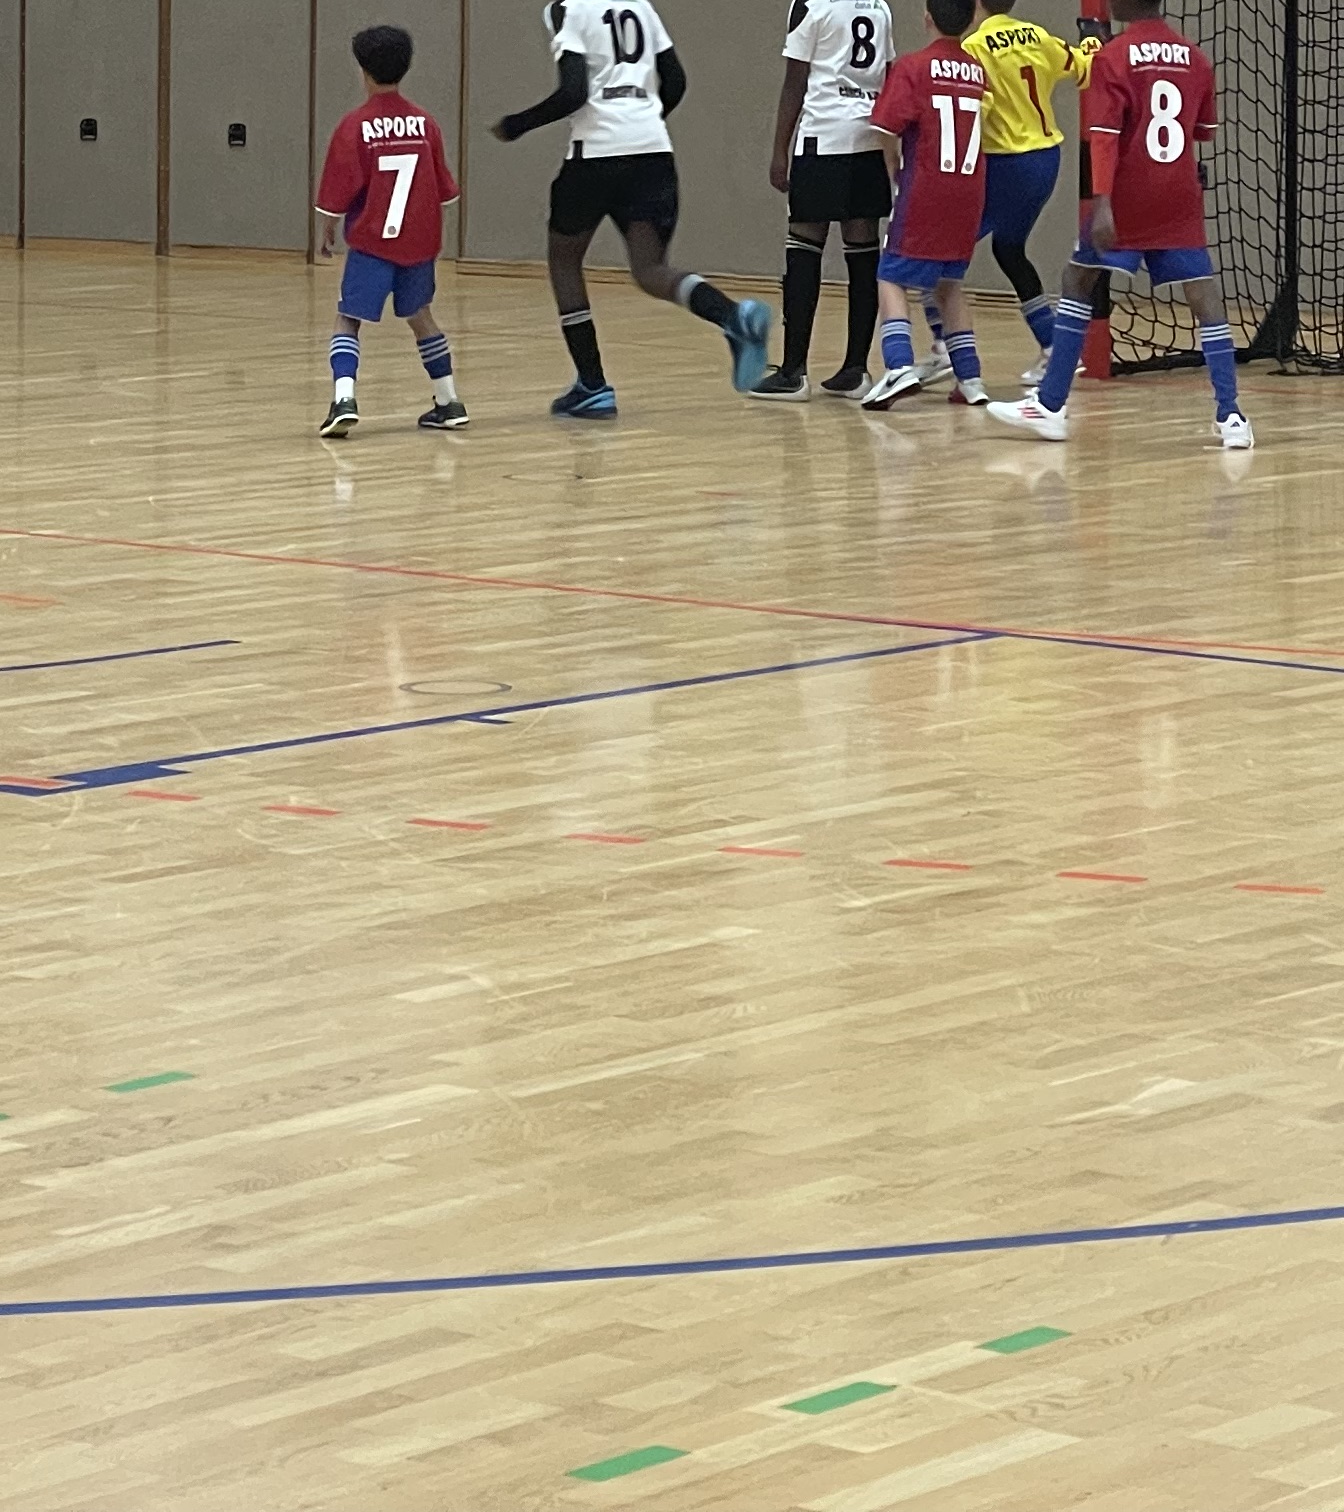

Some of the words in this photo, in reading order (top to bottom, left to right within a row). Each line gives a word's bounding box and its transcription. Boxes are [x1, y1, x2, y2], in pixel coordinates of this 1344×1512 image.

[601, 8, 645, 66] 10
[850, 16, 876, 69] 8
[985, 27, 1042, 53] ASPORT
[1129, 42, 1191, 66] ASPORT
[930, 59, 984, 84] ASPORT
[1019, 65, 1053, 137] 1
[1146, 79, 1185, 163] 8
[361, 115, 426, 143] ASPORT
[931, 95, 982, 175] 17
[378, 154, 419, 239] 7
